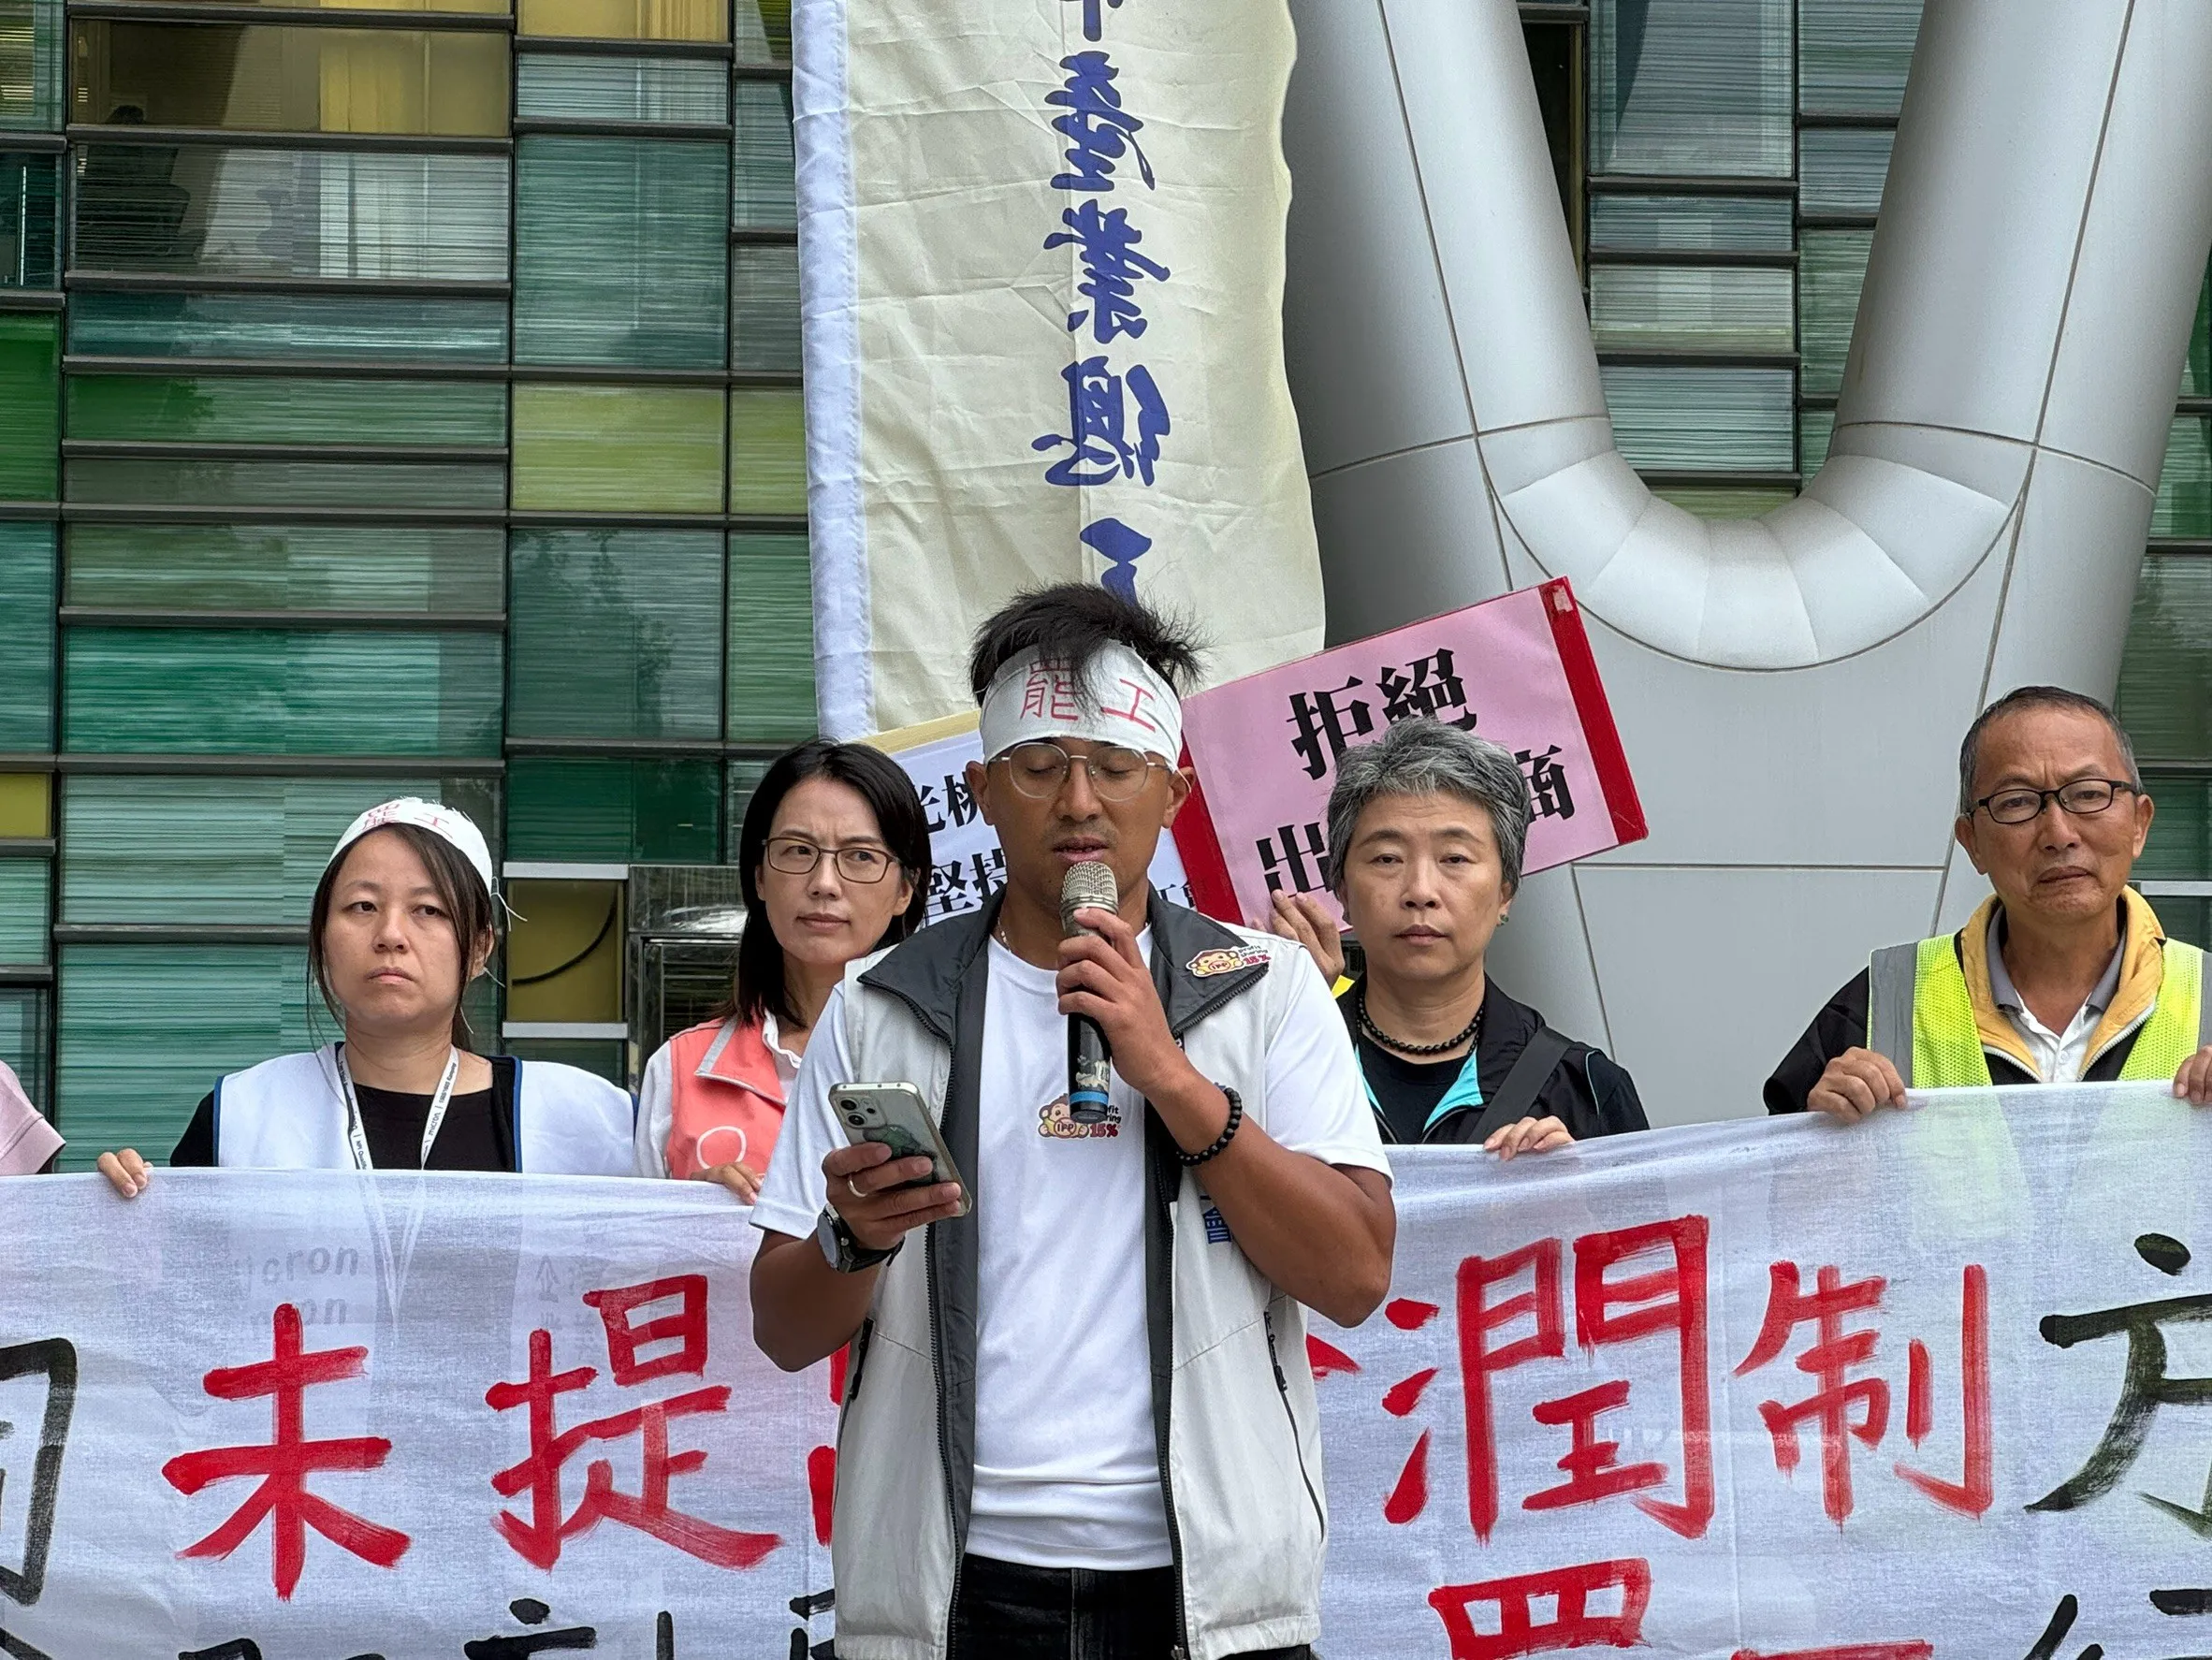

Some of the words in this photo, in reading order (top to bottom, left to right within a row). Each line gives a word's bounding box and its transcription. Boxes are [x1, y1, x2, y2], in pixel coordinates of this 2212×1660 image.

[1021, 657, 1156, 733] 罷工
[1287, 648, 1477, 780] 拒絕
[1090, 1123, 1118, 1138] 15%
